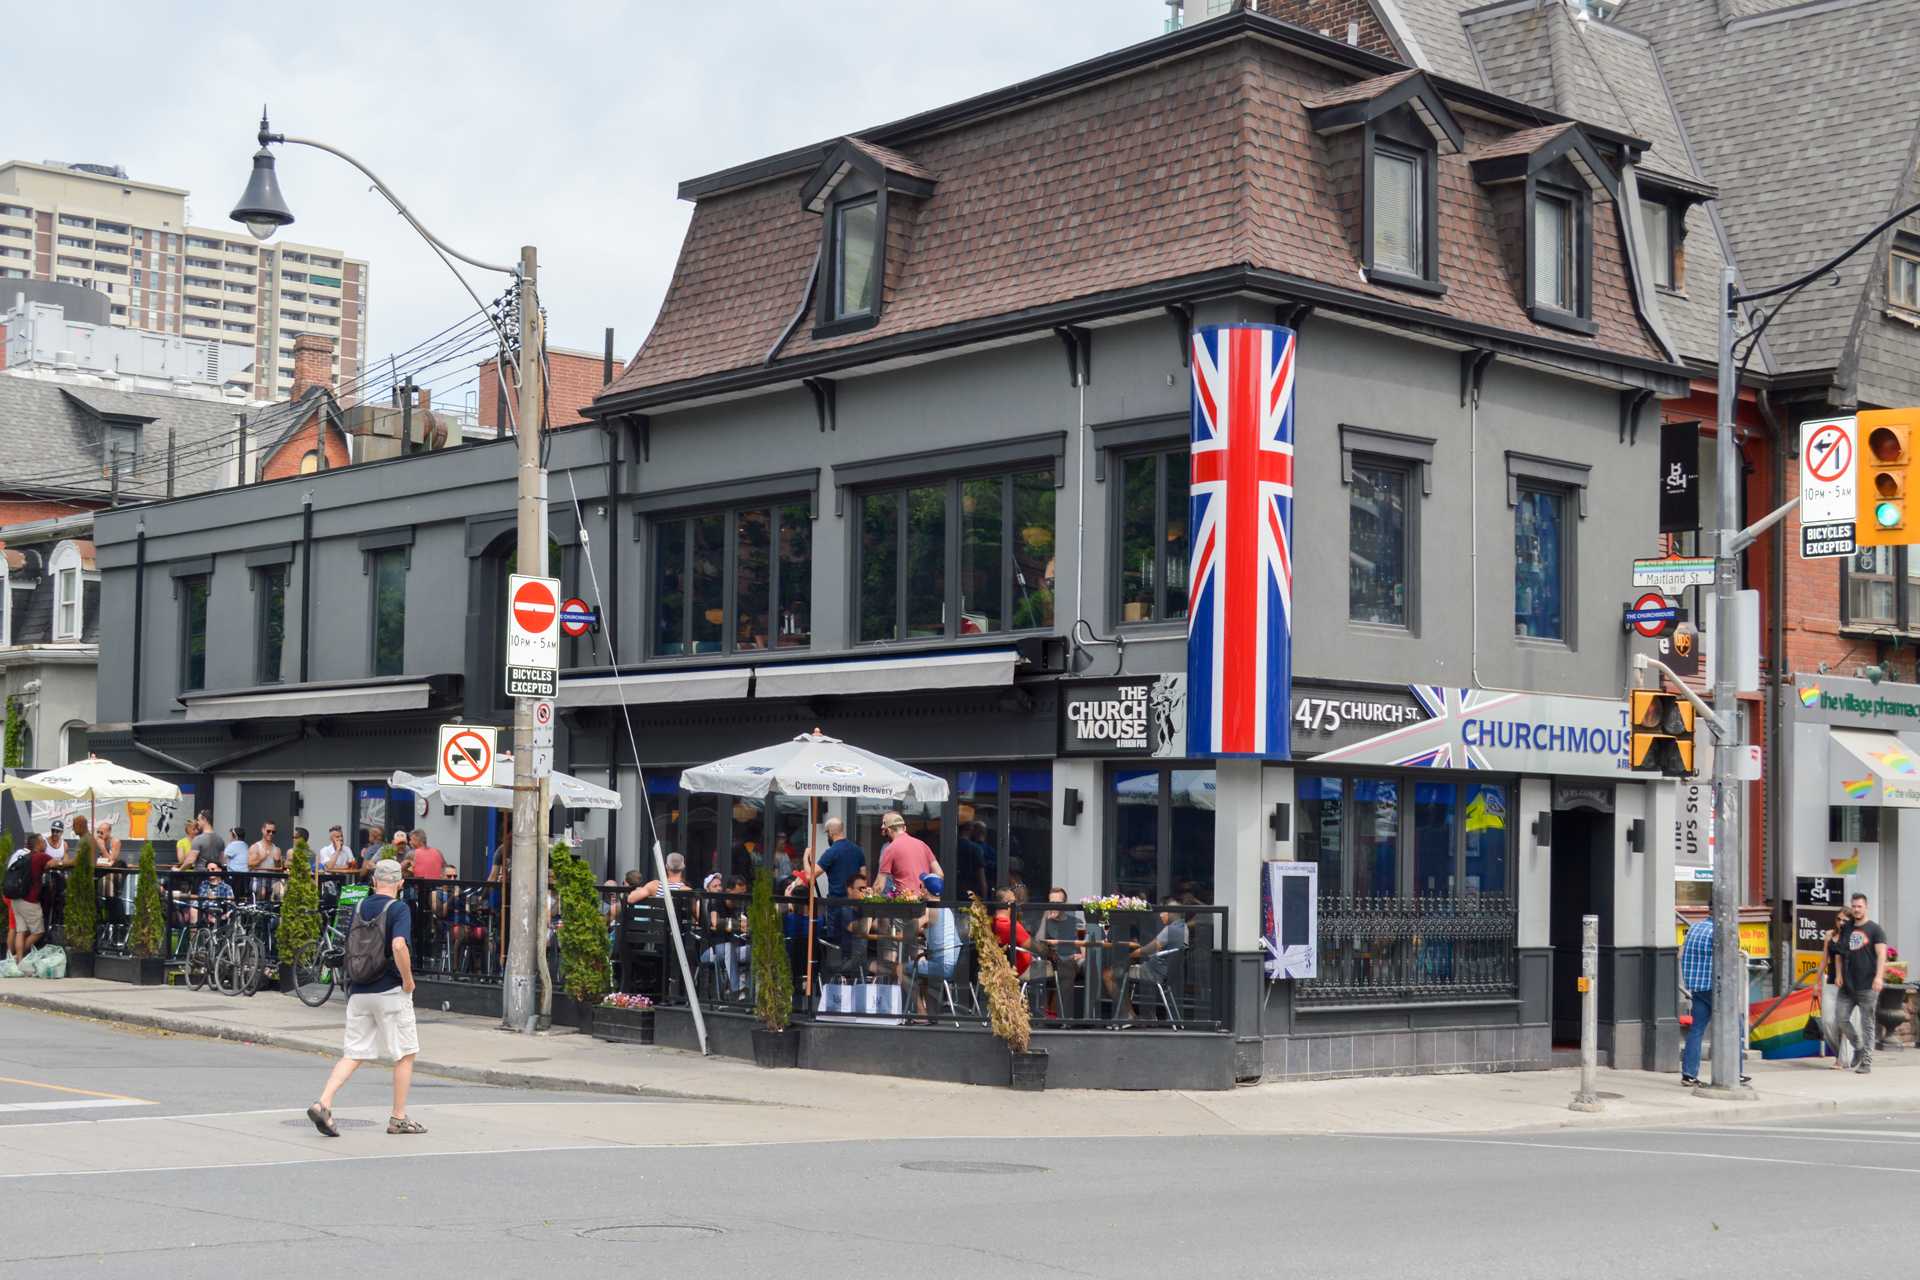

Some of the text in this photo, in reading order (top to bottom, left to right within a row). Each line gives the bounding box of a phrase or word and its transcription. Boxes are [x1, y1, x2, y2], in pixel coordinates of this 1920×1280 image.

[1807, 526, 1852, 540] BICYCLES
[1806, 540, 1853, 555] EXCEPTED
[1646, 573, 1686, 585] Maitland
[512, 668, 552, 681] BICYCLES
[511, 681, 553, 694] EXCEPTED
[1118, 686, 1148, 700] THE
[1067, 700, 1147, 720] CHURCH
[1820, 690, 1920, 721] the village pharmac
[1295, 698, 1420, 731] 475 CHURCH ST.
[1077, 719, 1148, 739] MOUSE
[1461, 719, 1630, 756] CHURCHMOUS
[795, 780, 894, 797] Creemore Springs Brewery
[1686, 820, 1698, 854] UPS
[1799, 917, 1817, 928] The
[1799, 929, 1818, 940] UPS
